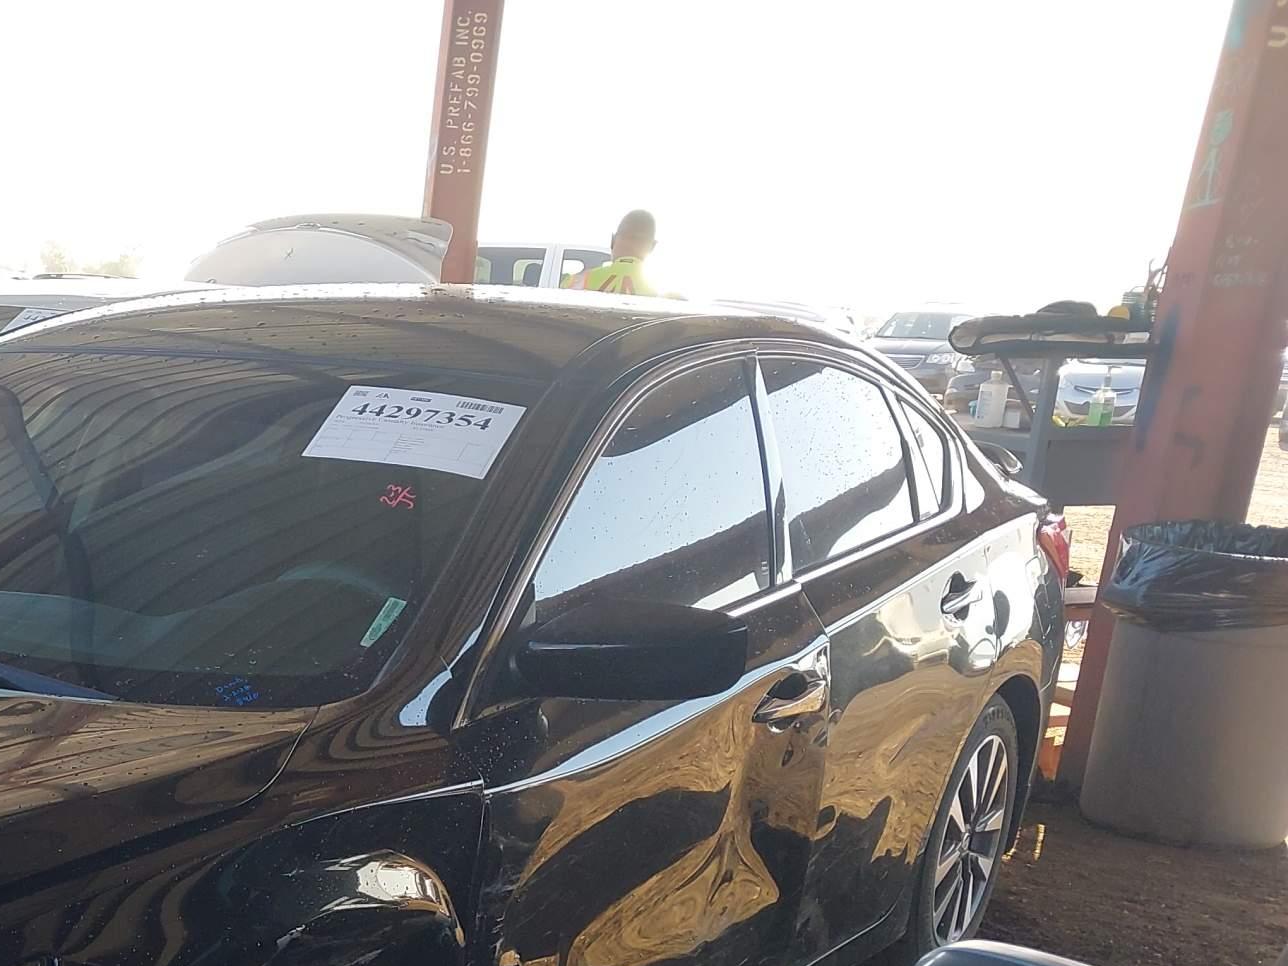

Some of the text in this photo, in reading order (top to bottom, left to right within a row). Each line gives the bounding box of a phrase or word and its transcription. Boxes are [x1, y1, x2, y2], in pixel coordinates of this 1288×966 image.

[440, 10, 472, 175] U.S. PREFAB INC.
[457, 12, 488, 174] 1-866-799-0969
[351, 402, 492, 431] 44297354
